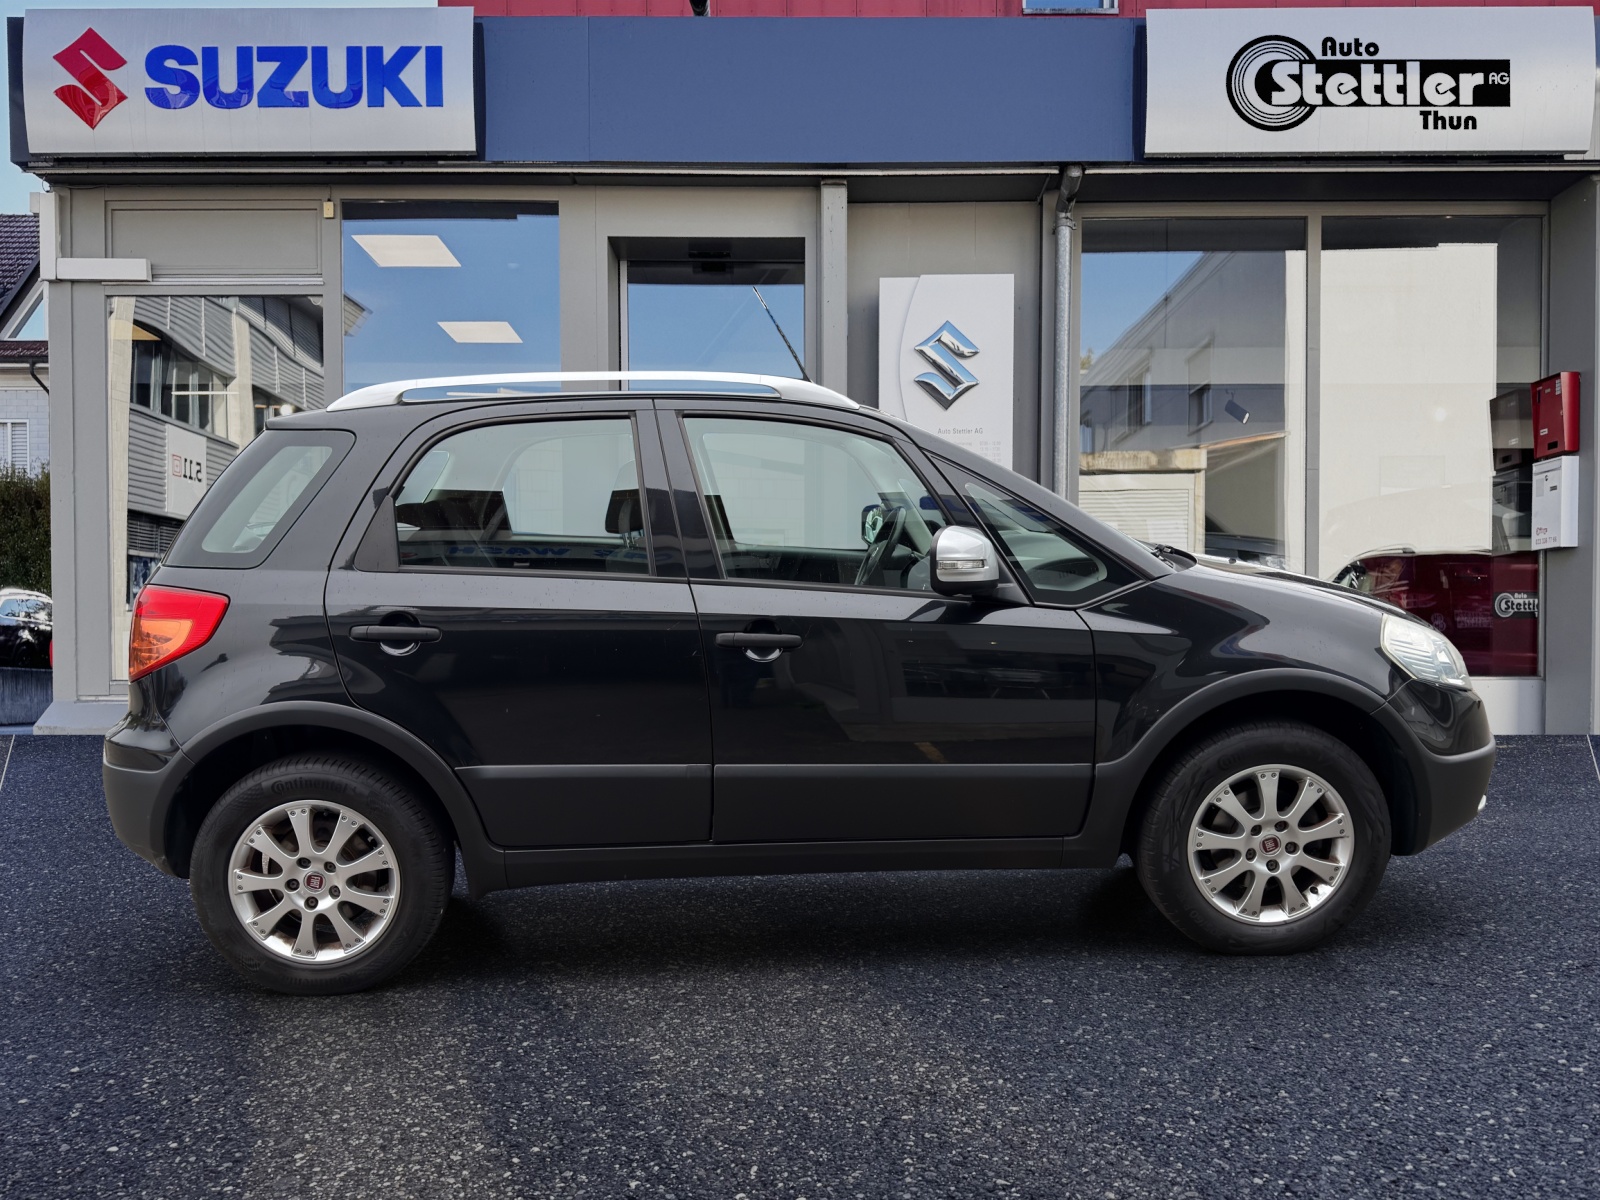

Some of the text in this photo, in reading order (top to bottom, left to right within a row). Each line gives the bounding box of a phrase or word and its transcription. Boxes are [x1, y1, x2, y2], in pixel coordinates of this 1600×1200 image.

[1321, 36, 1379, 57] Auto
[145, 44, 443, 109] SUZUKI
[1271, 61, 1509, 106] Stettler AG
[1419, 110, 1477, 130] Thun
[938, 427, 983, 435] Auto Stettler AG
